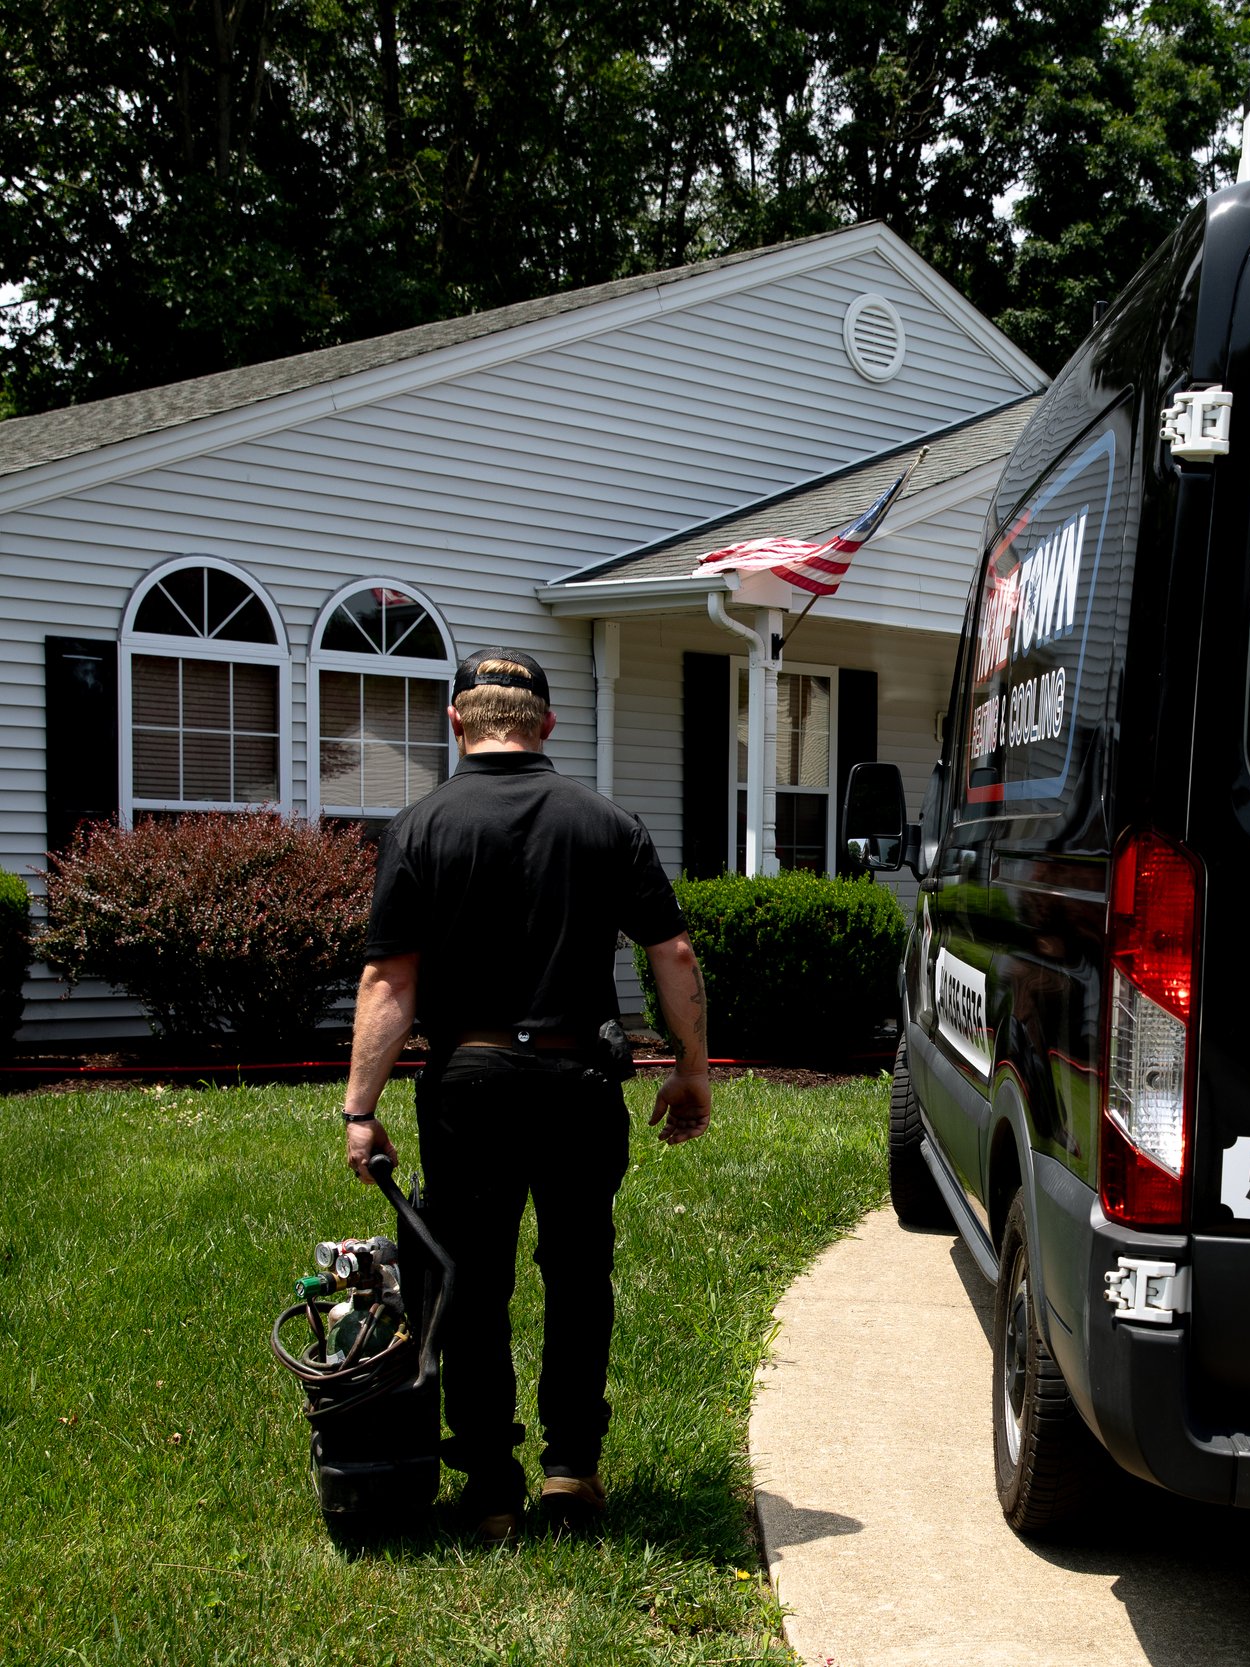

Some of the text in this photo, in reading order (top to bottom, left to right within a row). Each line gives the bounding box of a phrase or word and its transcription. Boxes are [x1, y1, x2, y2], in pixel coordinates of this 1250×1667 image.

[975, 505, 1089, 686] HOME TOWN
[1008, 667, 1065, 748] COOLING
